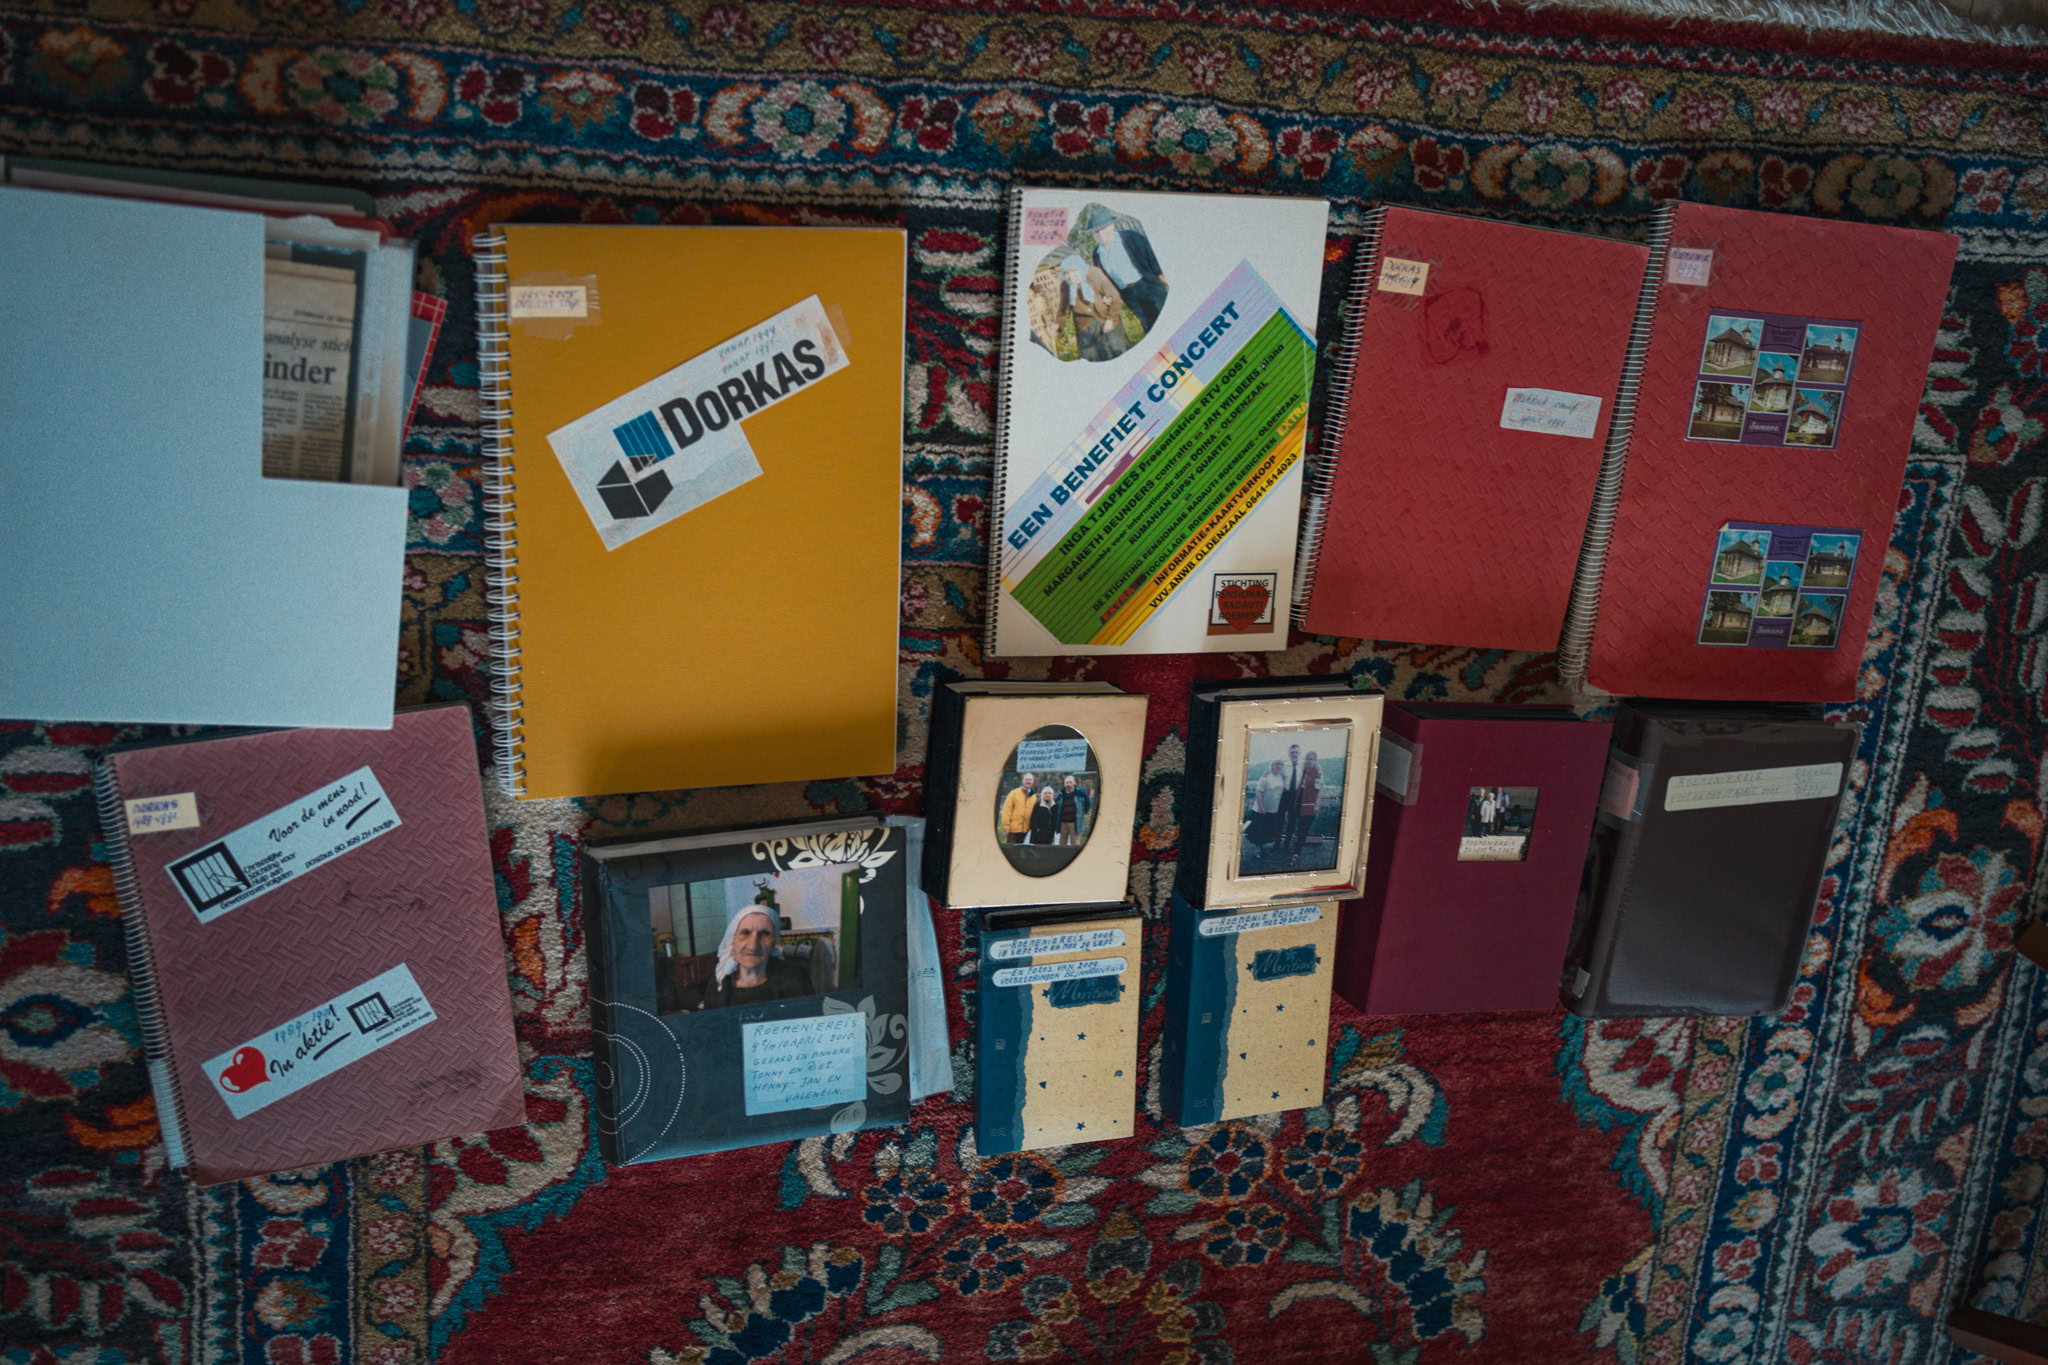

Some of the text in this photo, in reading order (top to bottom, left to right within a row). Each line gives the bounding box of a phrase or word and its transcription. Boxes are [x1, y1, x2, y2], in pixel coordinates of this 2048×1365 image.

[660, 339, 825, 449] DORKAS
[1007, 302, 1243, 549] EEN BENEFIET CONCERT
[1043, 532, 1106, 596] MARGARETH
[1100, 478, 1156, 535] BEUNDERS
[1151, 437, 1194, 482] contralto
[1200, 409, 1222, 431] JAN
[1219, 366, 1262, 411] WILBERS
[1058, 353, 1250, 556] INGA TJAPKES Presentatrice RTV OOST
[1075, 378, 1269, 583] Ensemble voor internationale dans DOINA OLDENZAAL
[1127, 432, 1235, 545] RUMANIAN GIPSY QUARTET
[1186, 490, 1226, 531] ROEMENIE
[1233, 435, 1278, 481] GEDICHTEN
[1273, 399, 1311, 437] EXTRA
[1102, 556, 1144, 600] STICHTING
[1141, 510, 1189, 560] PENSIONARE
[1186, 477, 1220, 512] RADAUTI
[1216, 438, 1257, 480] ROEMENIE
[1256, 390, 1302, 438] OLDENZAAL
[1148, 450, 1299, 609] VVV-ANWB OLDENZAAL 0541-514023
[1215, 590, 1272, 598] PENSIONARE
[1218, 611, 1265, 619] ROEMENIE
[1221, 579, 1269, 587] STICHTING
[1222, 600, 1264, 608] RADAUTI
[268, 785, 347, 842] Voor de mens
[322, 781, 368, 829] in nood!
[279, 850, 298, 864] voor
[1053, 979, 1118, 1001] Maritime
[270, 1059, 294, 1077] In
[295, 1004, 342, 1063] aktie!
[753, 1054, 793, 1066] GERARD
